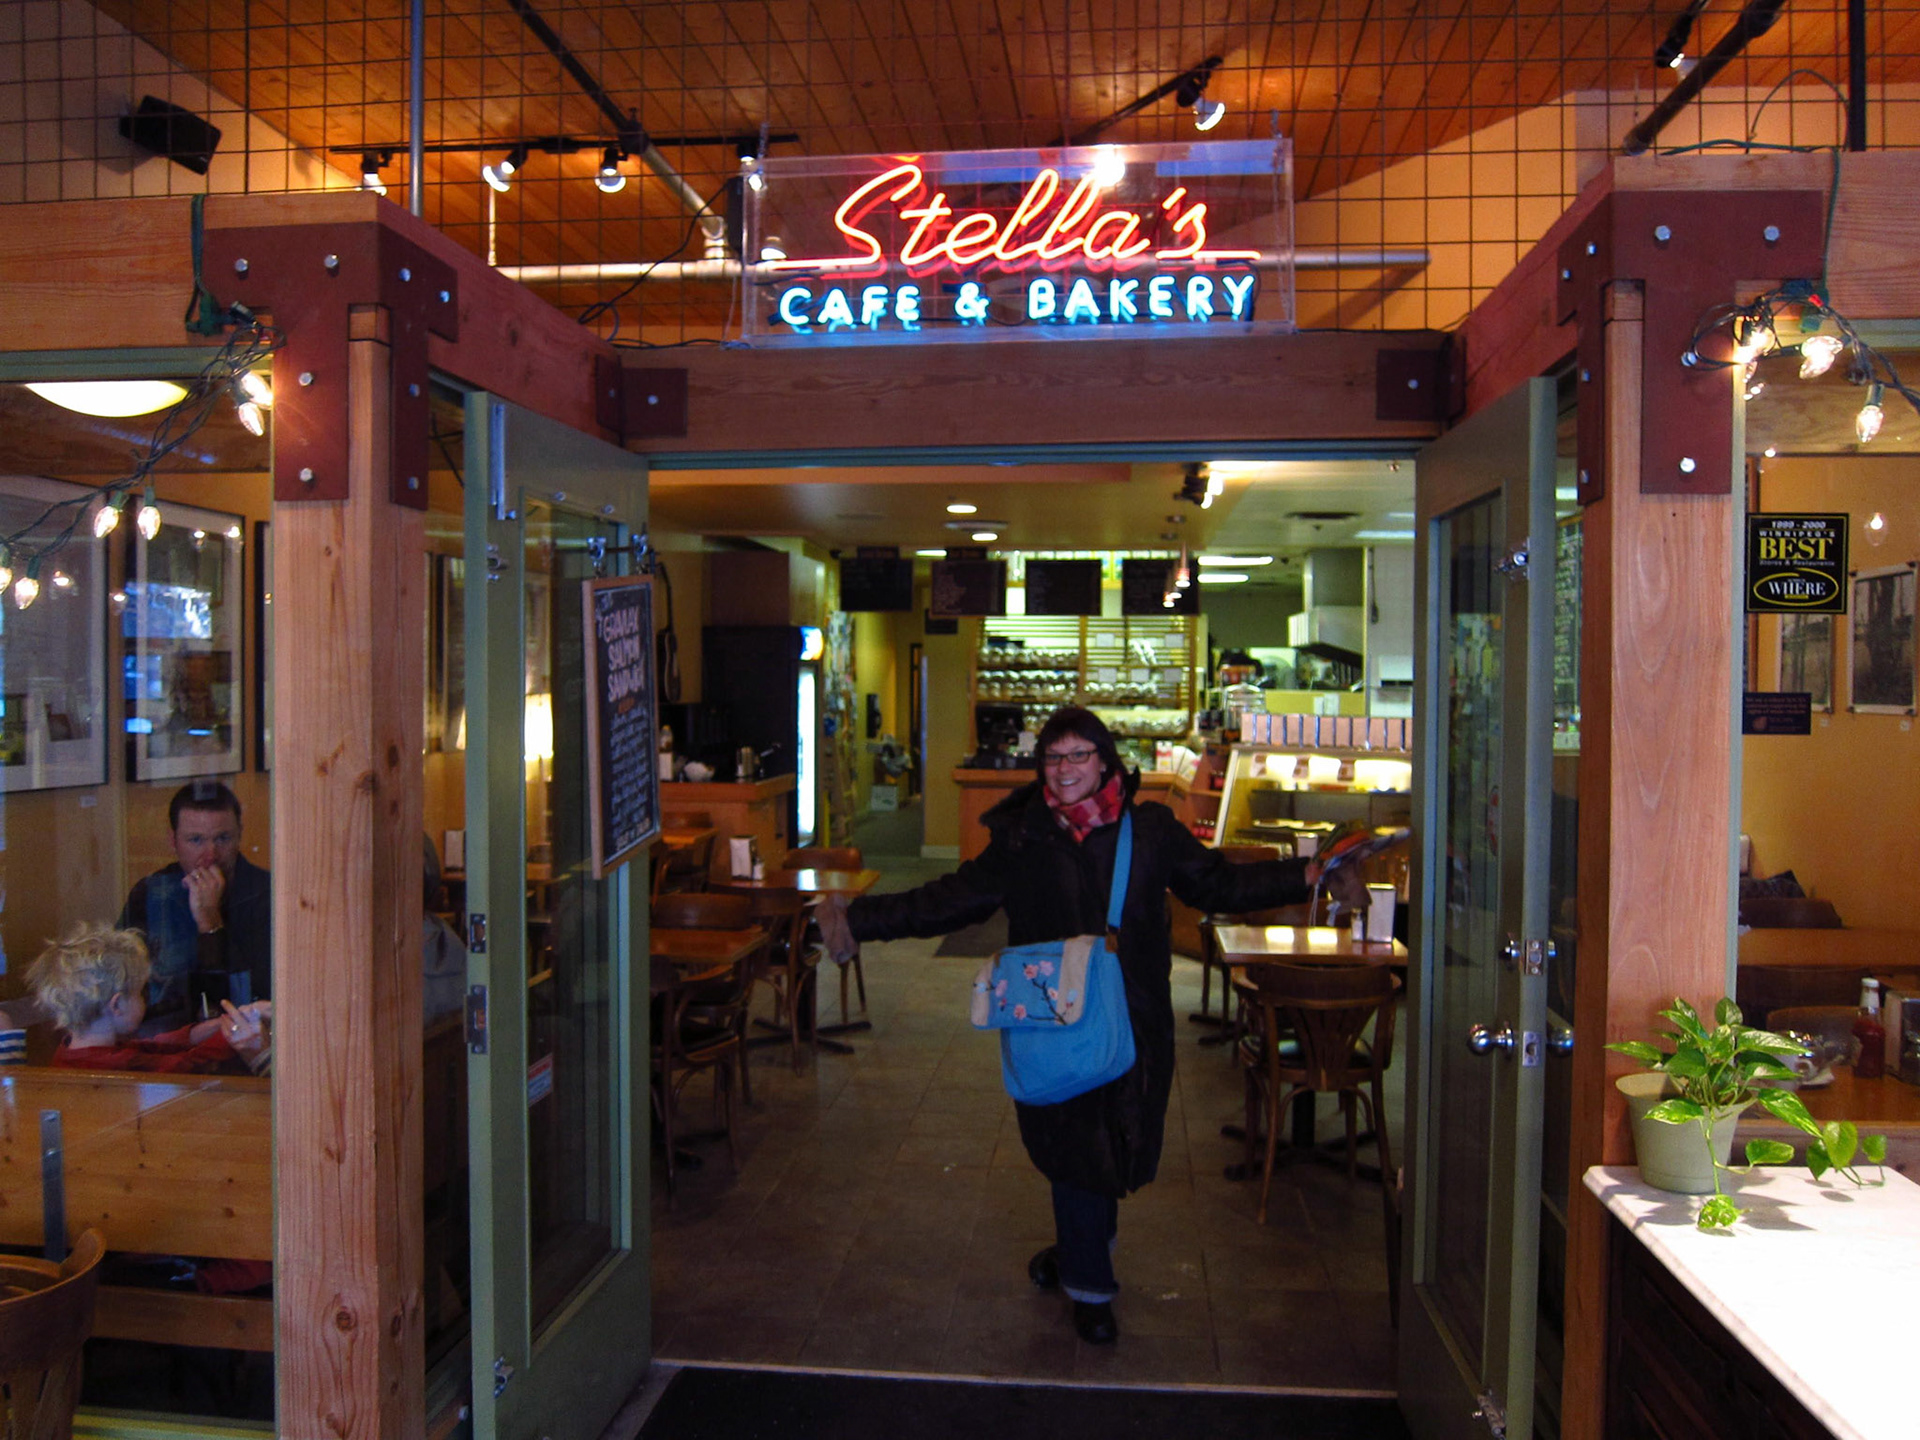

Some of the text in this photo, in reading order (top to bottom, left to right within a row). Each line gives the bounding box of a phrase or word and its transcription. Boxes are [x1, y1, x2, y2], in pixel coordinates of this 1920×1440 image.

[768, 164, 1262, 269] Stella's
[780, 275, 1255, 325] CAFE & BAKERY
[1802, 520, 1827, 529] 2000
[1758, 537, 1834, 560] BEST
[1768, 581, 1826, 596] WHERE
